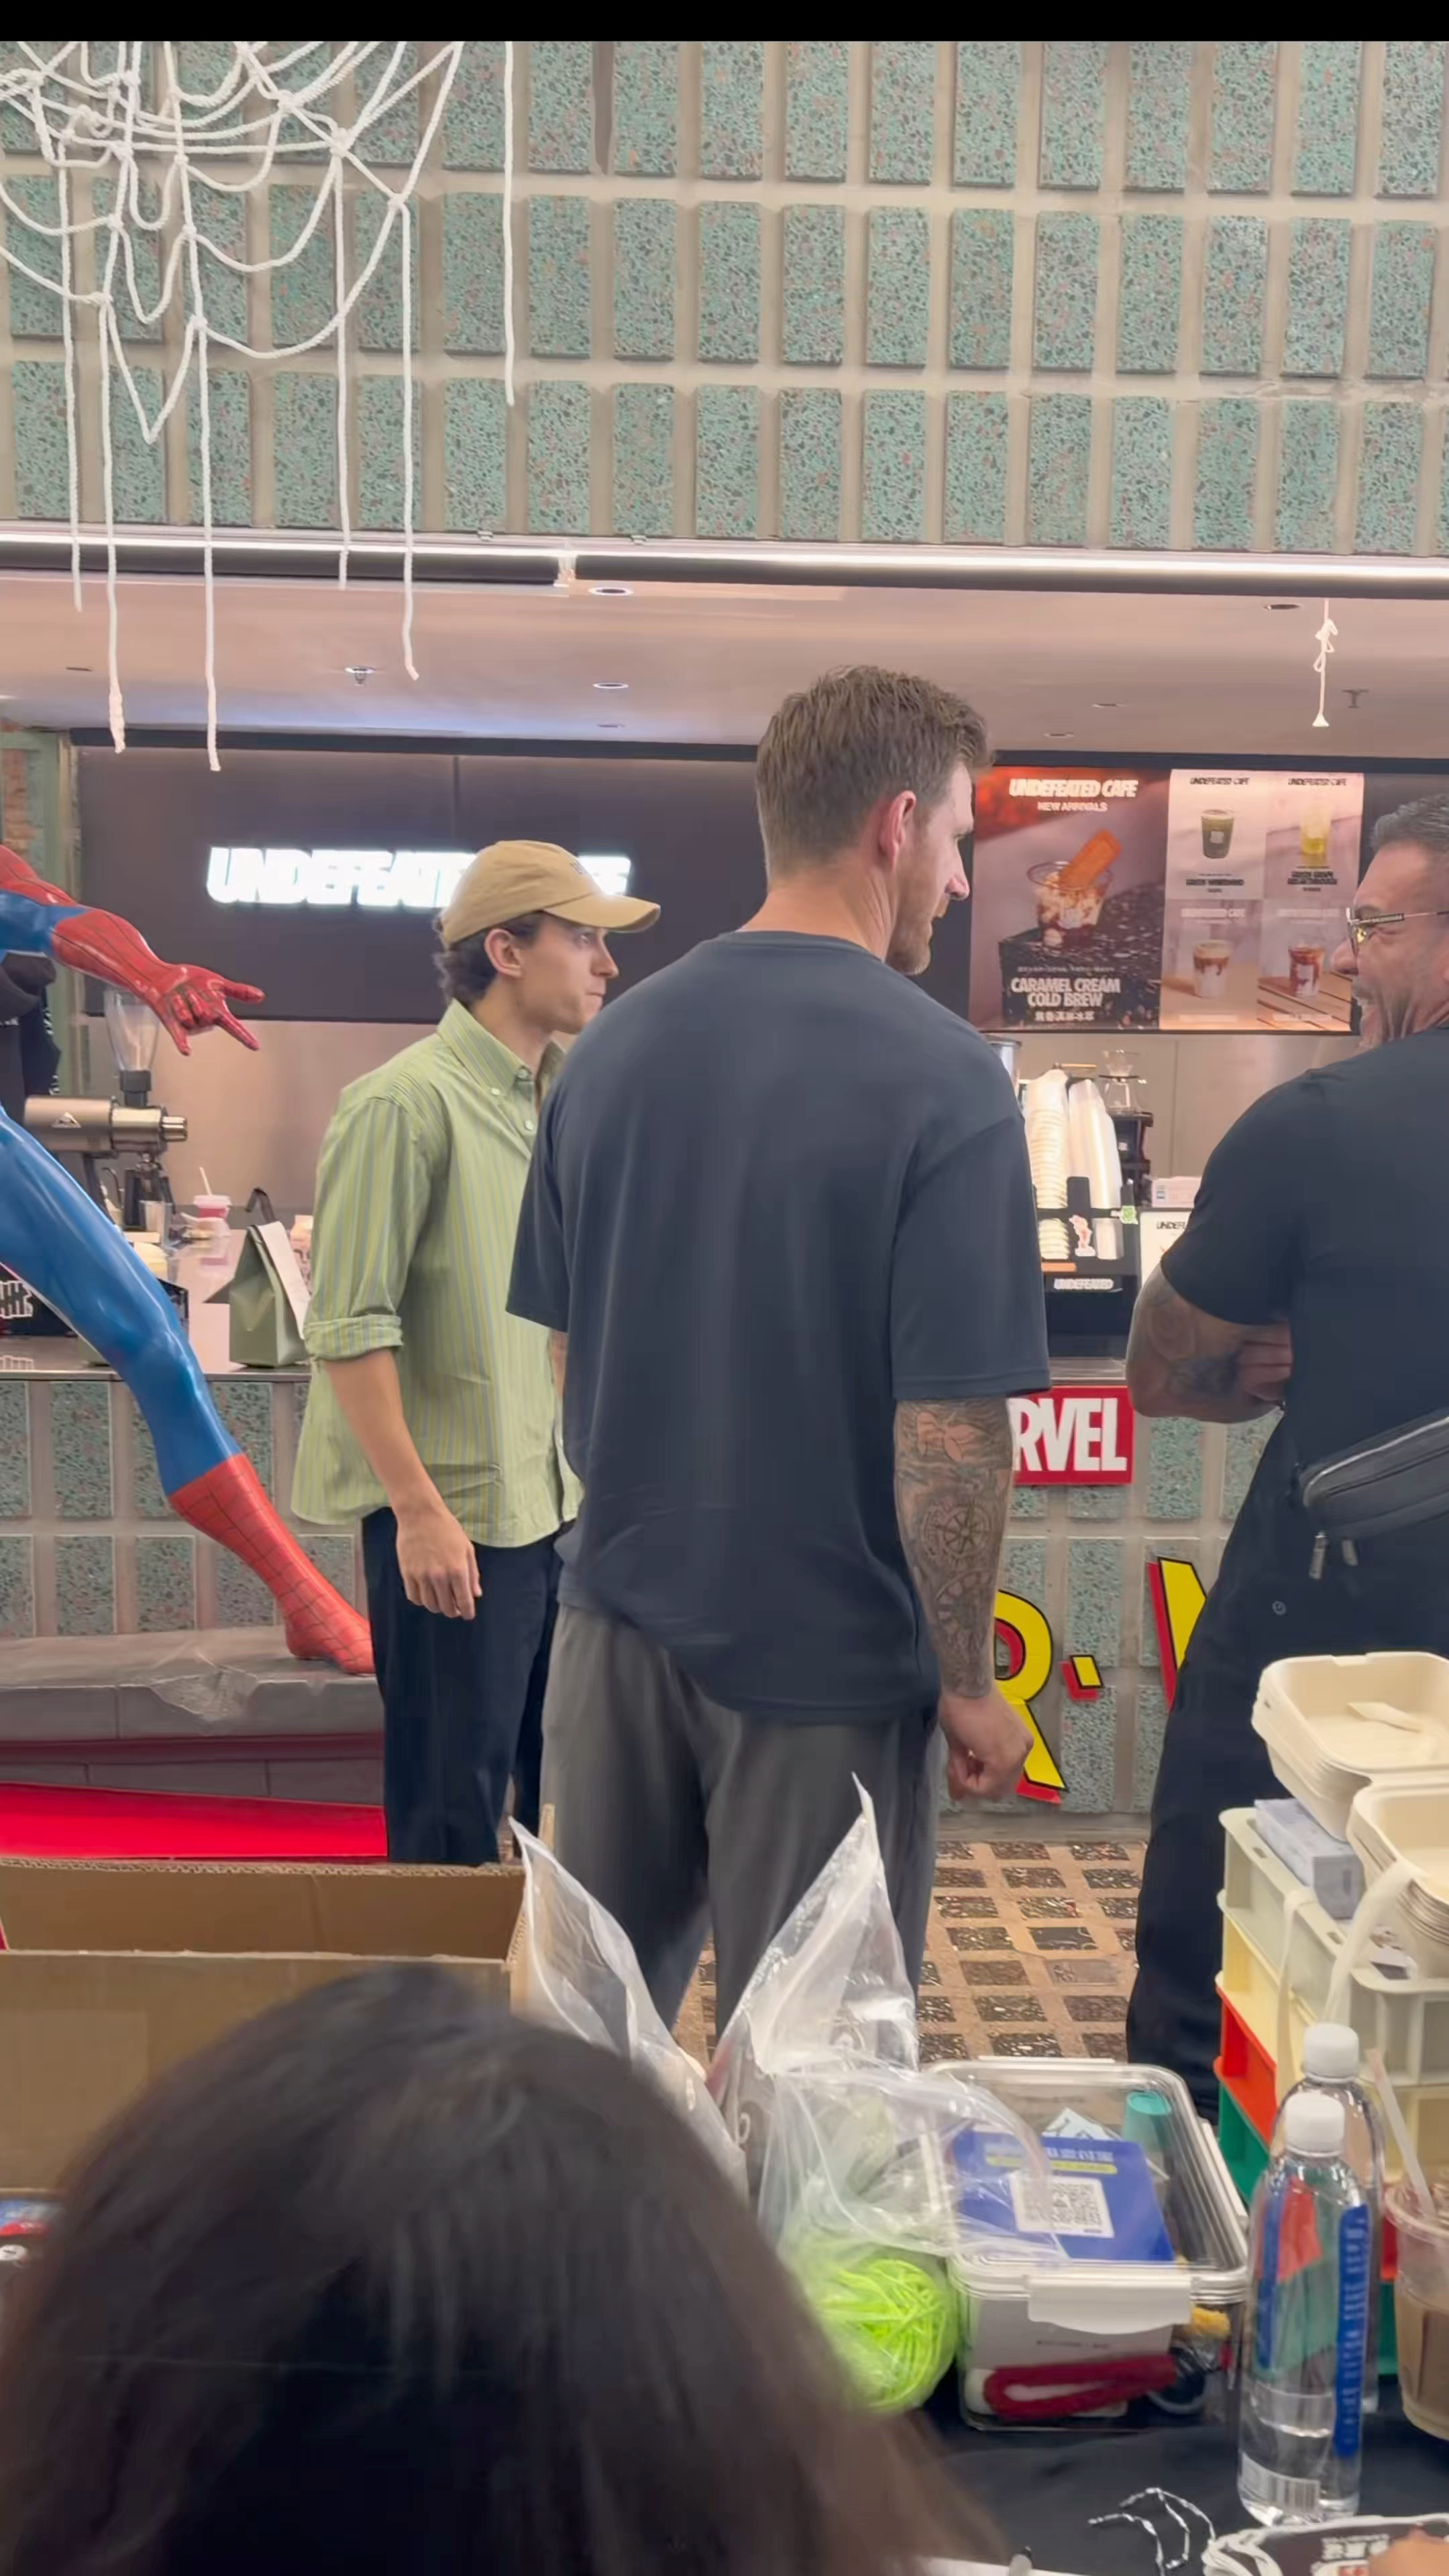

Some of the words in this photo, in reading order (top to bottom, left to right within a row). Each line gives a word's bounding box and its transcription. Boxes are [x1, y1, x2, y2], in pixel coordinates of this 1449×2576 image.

[1009, 779, 1101, 797] UNDEFEATED
[1102, 780, 1138, 797] CAFE
[1038, 802, 1061, 810] NEW
[1062, 802, 1108, 812] ARRIVALS
[1011, 977, 1072, 993] CARAMEL
[1075, 978, 1121, 993] CREAM
[1028, 993, 1061, 1007] COLD
[1063, 993, 1102, 1007] BREW
[1008, 1397, 1128, 1471] RVEL
